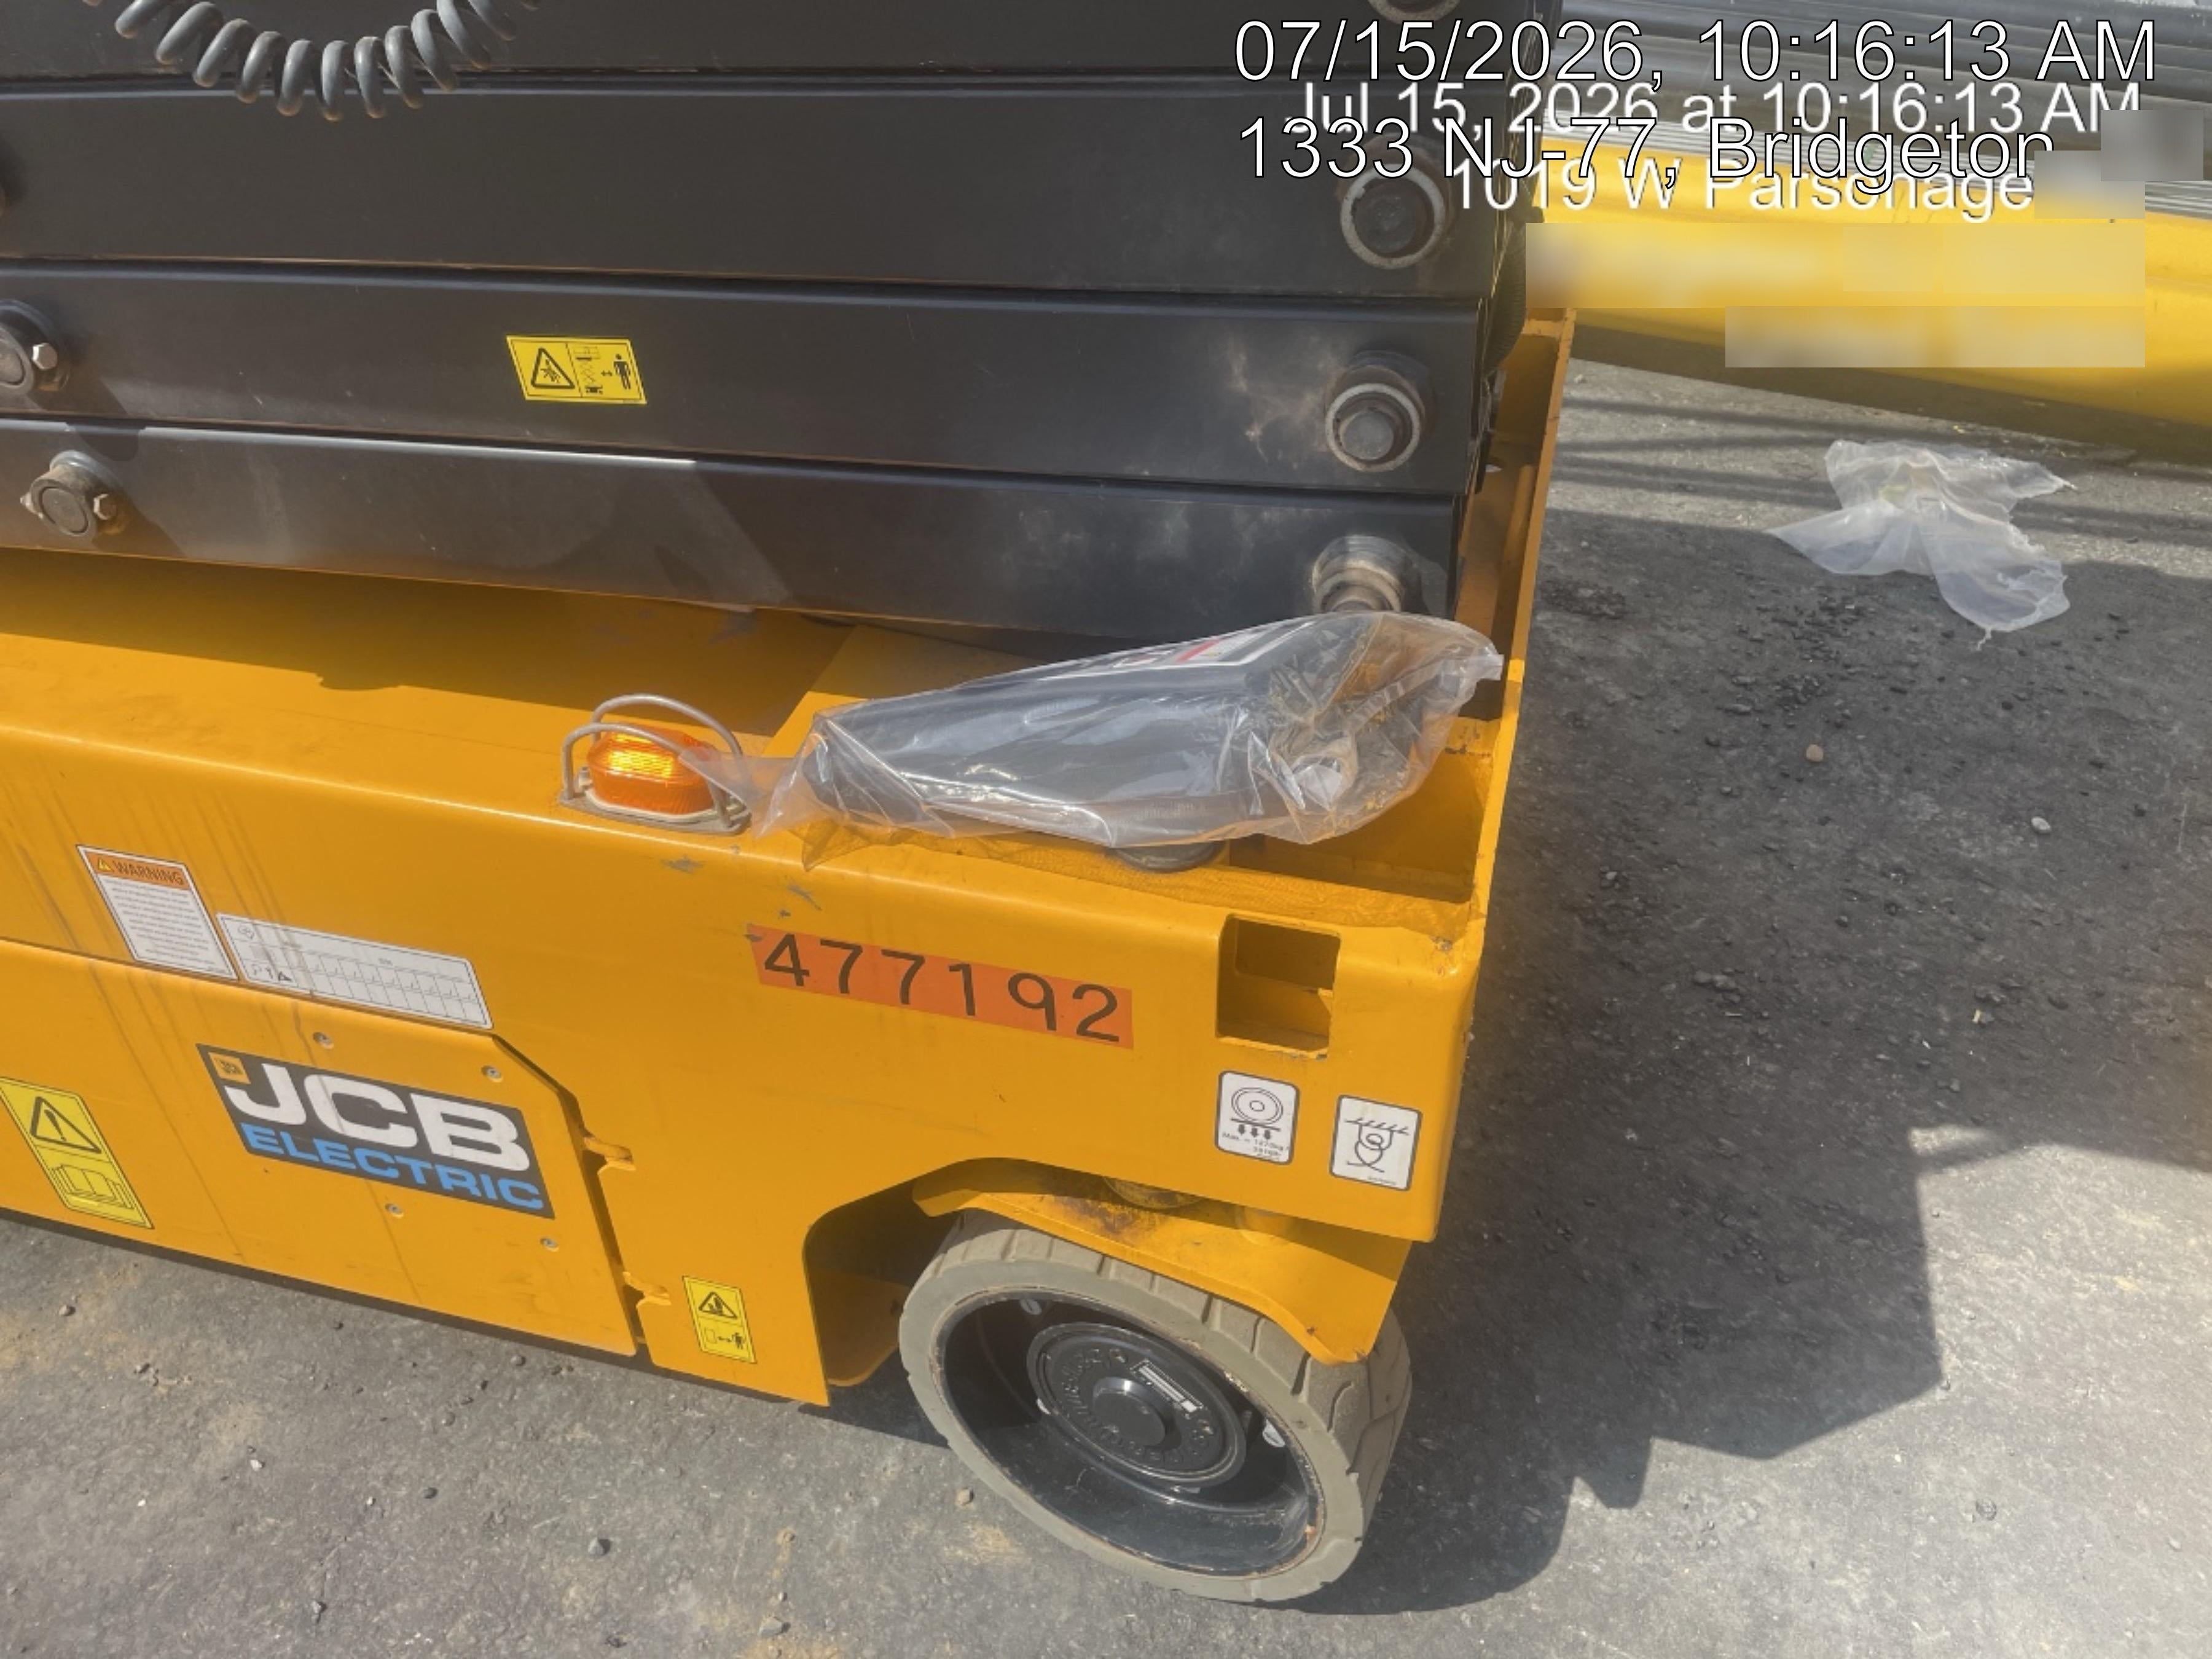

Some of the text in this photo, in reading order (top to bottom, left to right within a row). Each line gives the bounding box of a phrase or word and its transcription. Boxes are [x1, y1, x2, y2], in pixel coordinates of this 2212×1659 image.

[112, 860, 184, 885] WARNING
[764, 933, 1120, 1043] 477192
[224, 1063, 530, 1172] JCB
[241, 1123, 544, 1210] ELECTRIC
